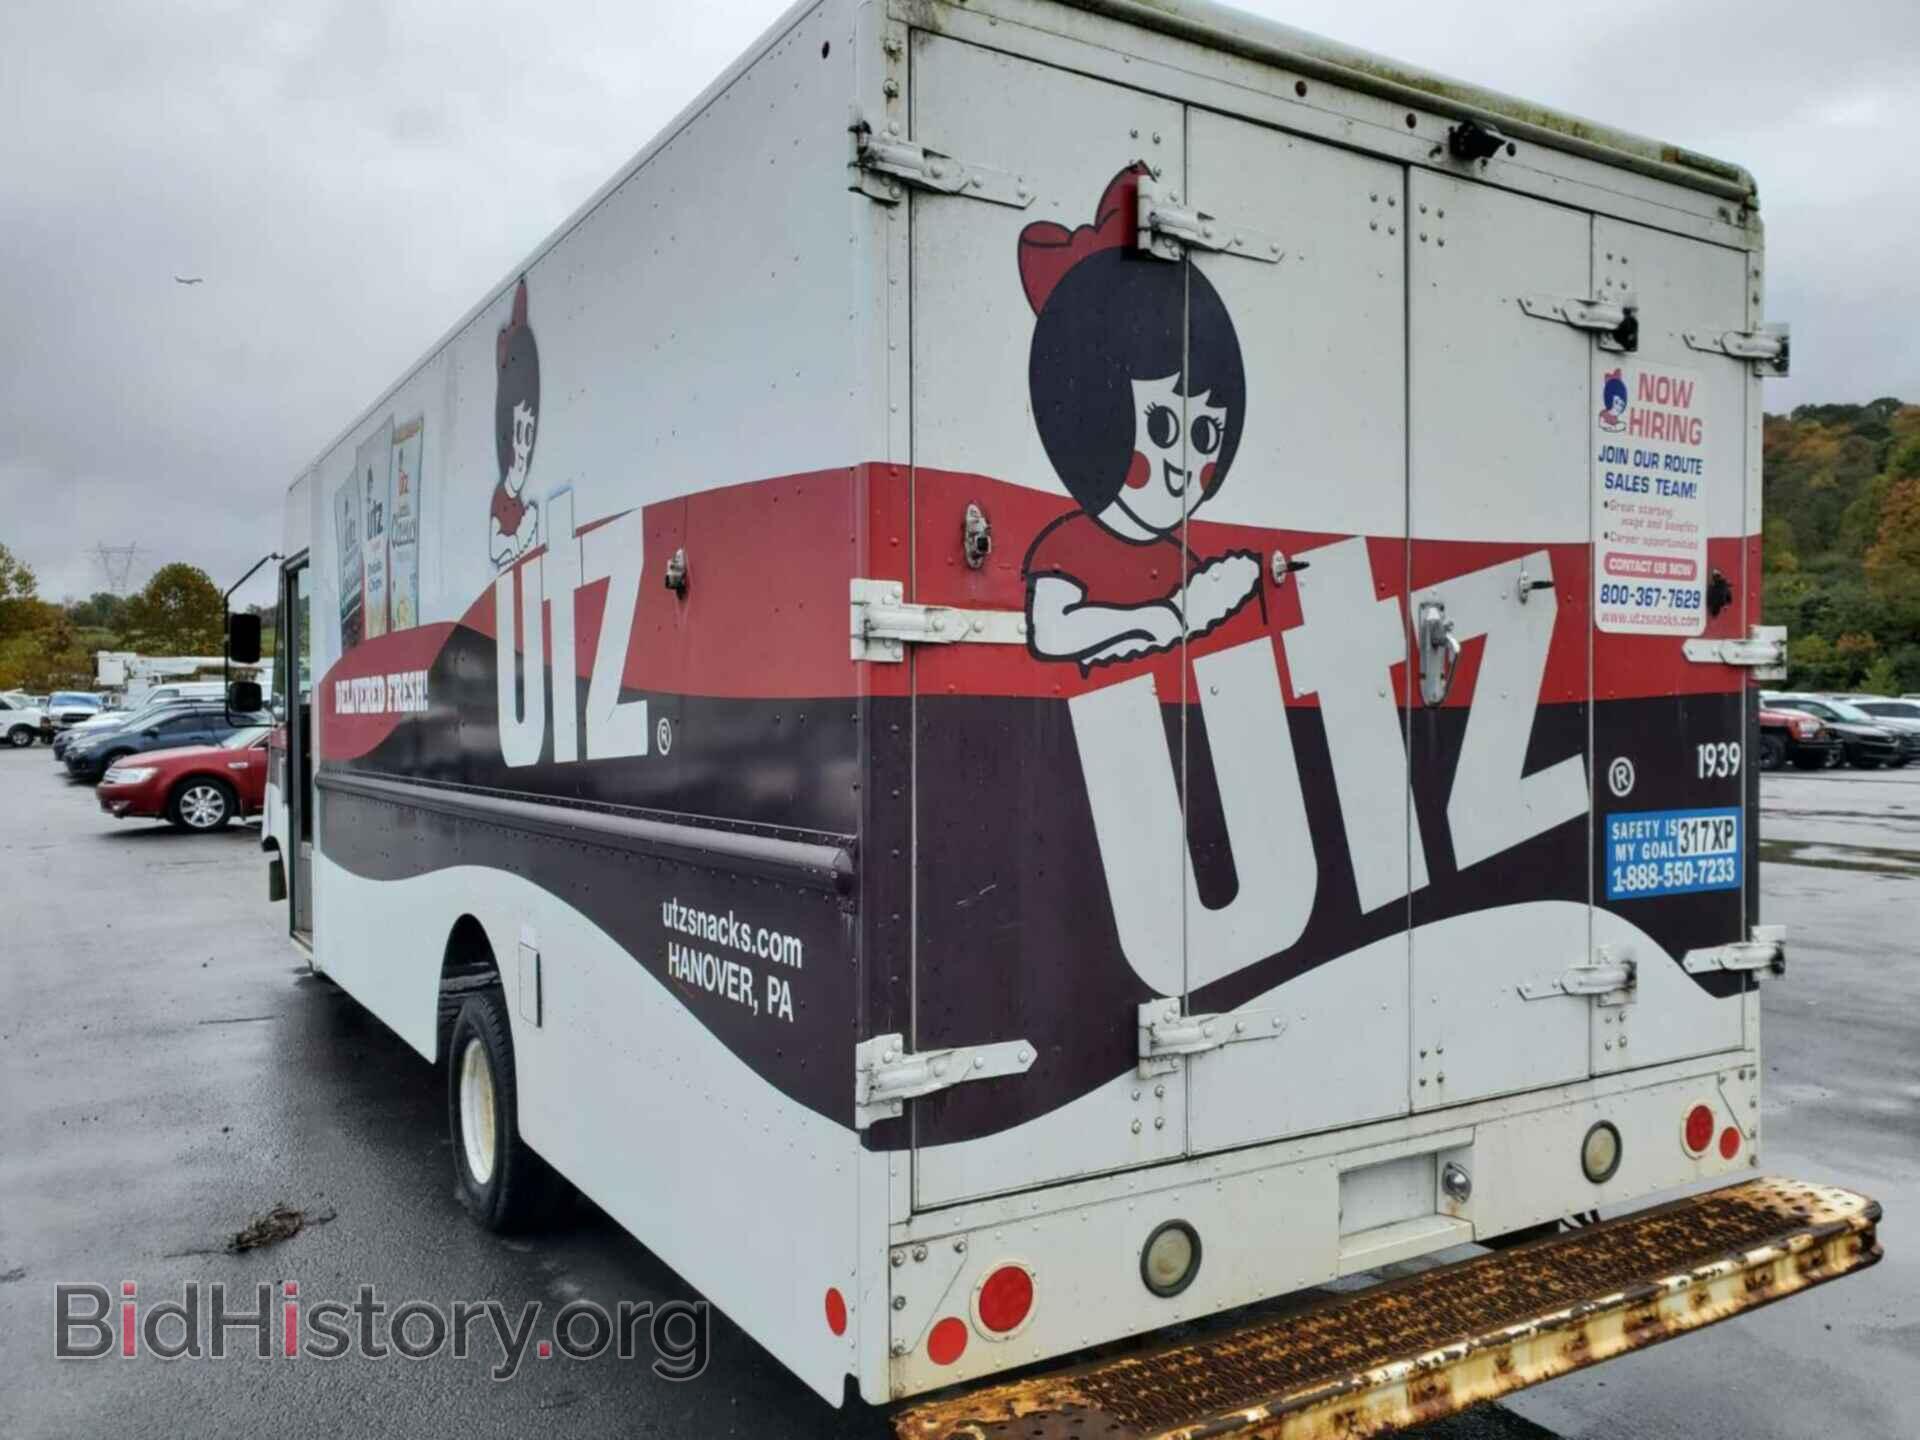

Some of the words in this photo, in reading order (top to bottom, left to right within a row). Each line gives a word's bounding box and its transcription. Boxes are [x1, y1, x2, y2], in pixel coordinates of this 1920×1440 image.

[1638, 372, 1695, 409] NOW
[1628, 406, 1703, 446] HIRING
[1598, 445, 1628, 466] JOIN
[1634, 449, 1659, 470] OUR
[1664, 453, 1703, 476] ROUTE
[1604, 471, 1649, 494] SALES
[1655, 476, 1697, 500] TEAM!
[1608, 557, 1653, 573] CONTACT
[1654, 562, 1667, 575] US
[1668, 563, 1694, 577] NOW
[1600, 583, 1702, 610] 800-367-7629
[335, 675, 386, 715] DELIVERED
[386, 669, 429, 713] FRESH!
[1697, 742, 1742, 779] 1939
[1612, 819, 1661, 840] SAFETY
[1665, 819, 1678, 837] IS
[1679, 819, 1735, 854] 317XP
[1615, 843, 1636, 863] MY
[1641, 841, 1676, 860] GOAL
[1612, 857, 1735, 893] 1-888-550-7233
[662, 896, 802, 969] utzsnacks.com
[668, 941, 759, 1016] HANOVER,
[767, 974, 794, 1023] PA
